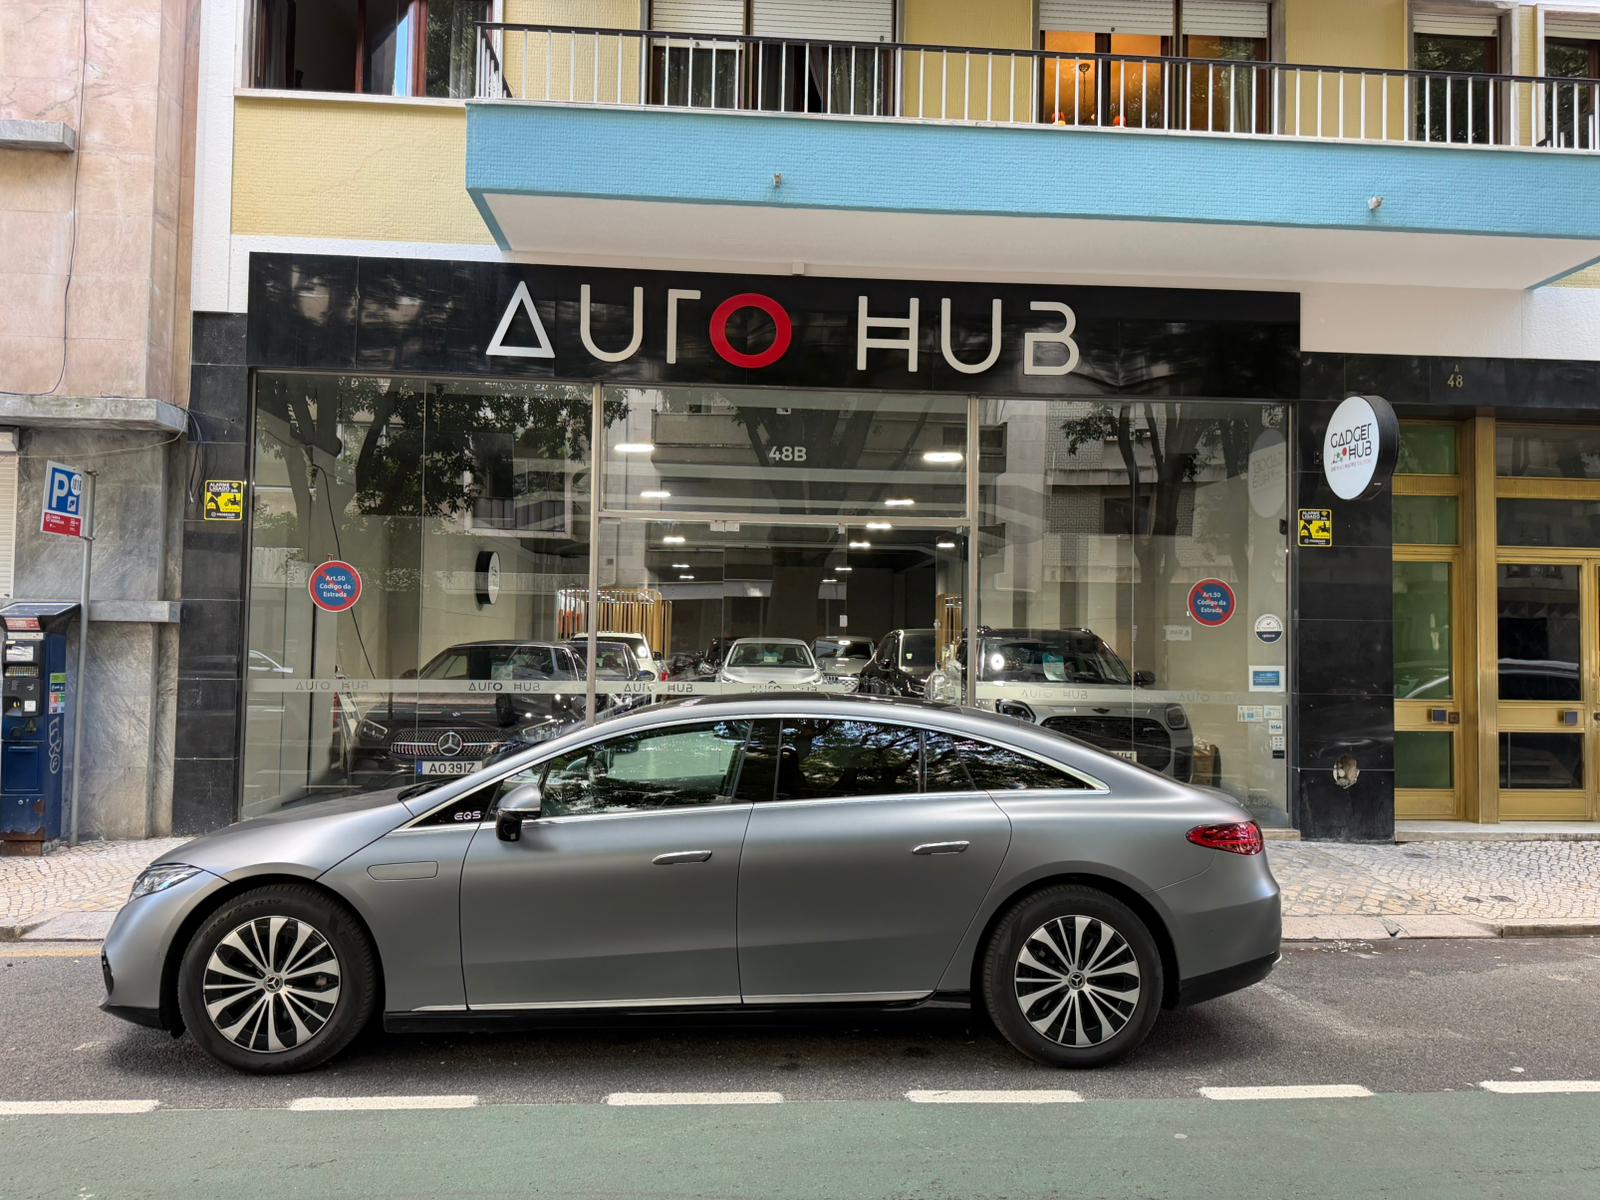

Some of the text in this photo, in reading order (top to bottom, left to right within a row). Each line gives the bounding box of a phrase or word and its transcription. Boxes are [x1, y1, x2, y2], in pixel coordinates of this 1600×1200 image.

[485, 280, 1081, 376] AUTO HUB
[1447, 374, 1464, 388] 48
[1330, 423, 1372, 448] GADGET
[768, 446, 807, 462] 48B
[1348, 440, 1372, 461] HUB
[51, 471, 69, 508] P
[468, 682, 541, 691] AUTO HUB
[667, 683, 694, 693] HUB
[453, 810, 481, 821] EQS
